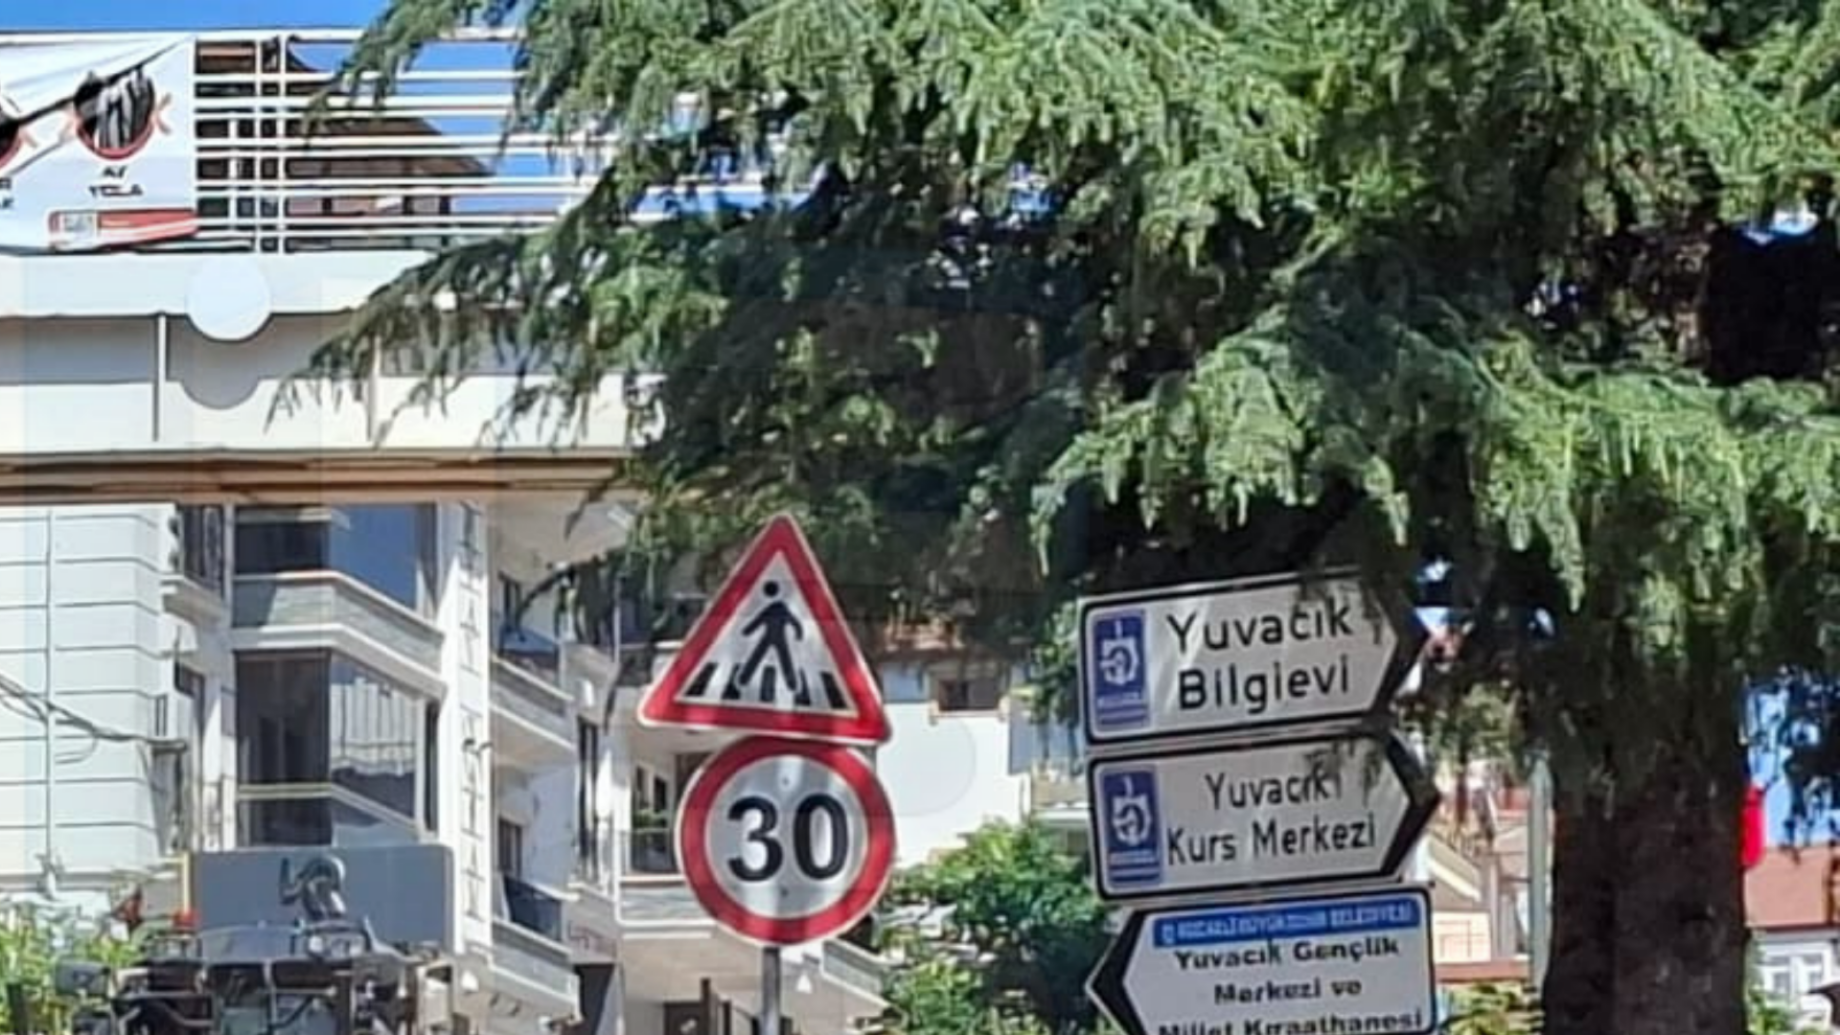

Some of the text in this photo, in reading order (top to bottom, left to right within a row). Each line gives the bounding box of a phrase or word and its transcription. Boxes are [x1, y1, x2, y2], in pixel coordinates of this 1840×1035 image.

[1166, 597, 1353, 655] Yuvacık
[1178, 654, 1348, 715] Bilgievi
[1205, 761, 1330, 811] Yuvacık
[726, 792, 849, 882] 30
[1167, 812, 1376, 865] Kurs Merkezi
[1175, 937, 1399, 970] Yuvacık Gençlik
[1214, 976, 1362, 1004] Merkezi ve
